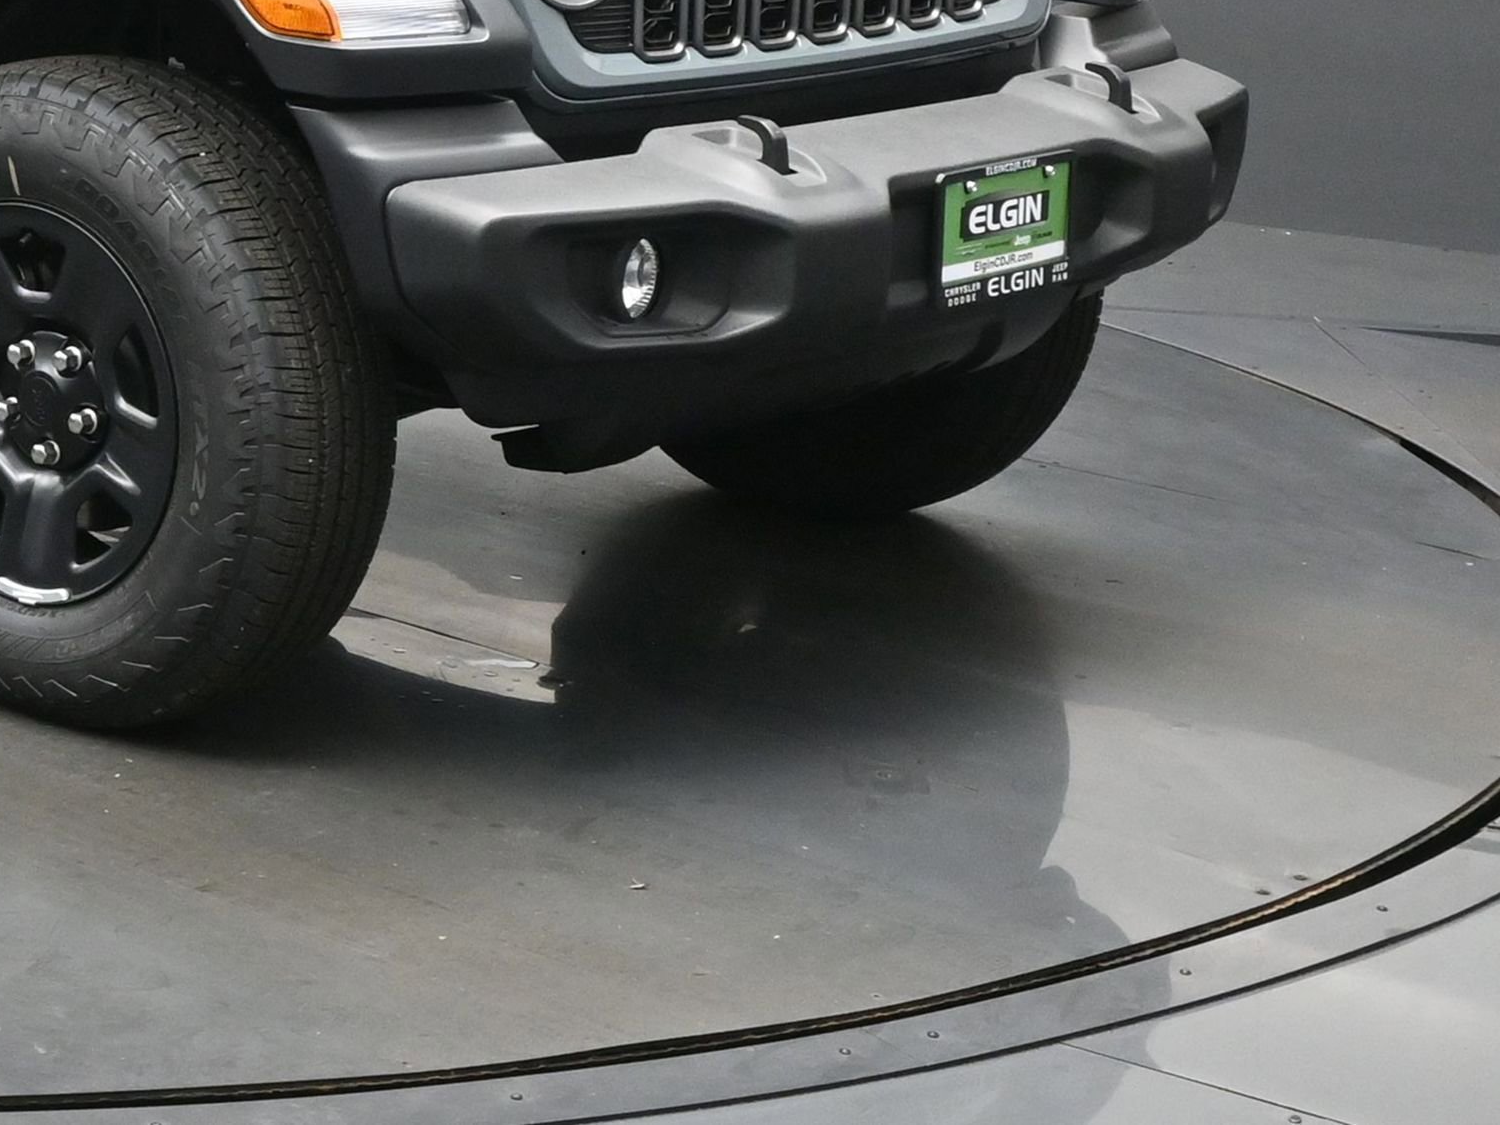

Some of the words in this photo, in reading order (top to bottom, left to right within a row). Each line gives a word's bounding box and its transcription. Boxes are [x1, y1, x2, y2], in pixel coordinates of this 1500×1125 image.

[986, 158, 1037, 176] ELGINCDJR.COM
[968, 193, 1043, 235] ELGIN
[1014, 234, 1032, 246] Jeep
[974, 251, 1034, 274] ElginCDJR.com
[1052, 262, 1068, 274] JEEP
[987, 267, 1044, 297] ELGIN
[1052, 272, 1068, 283] RAM
[945, 282, 981, 298] CHRYSLER
[948, 293, 977, 307] DODGE
